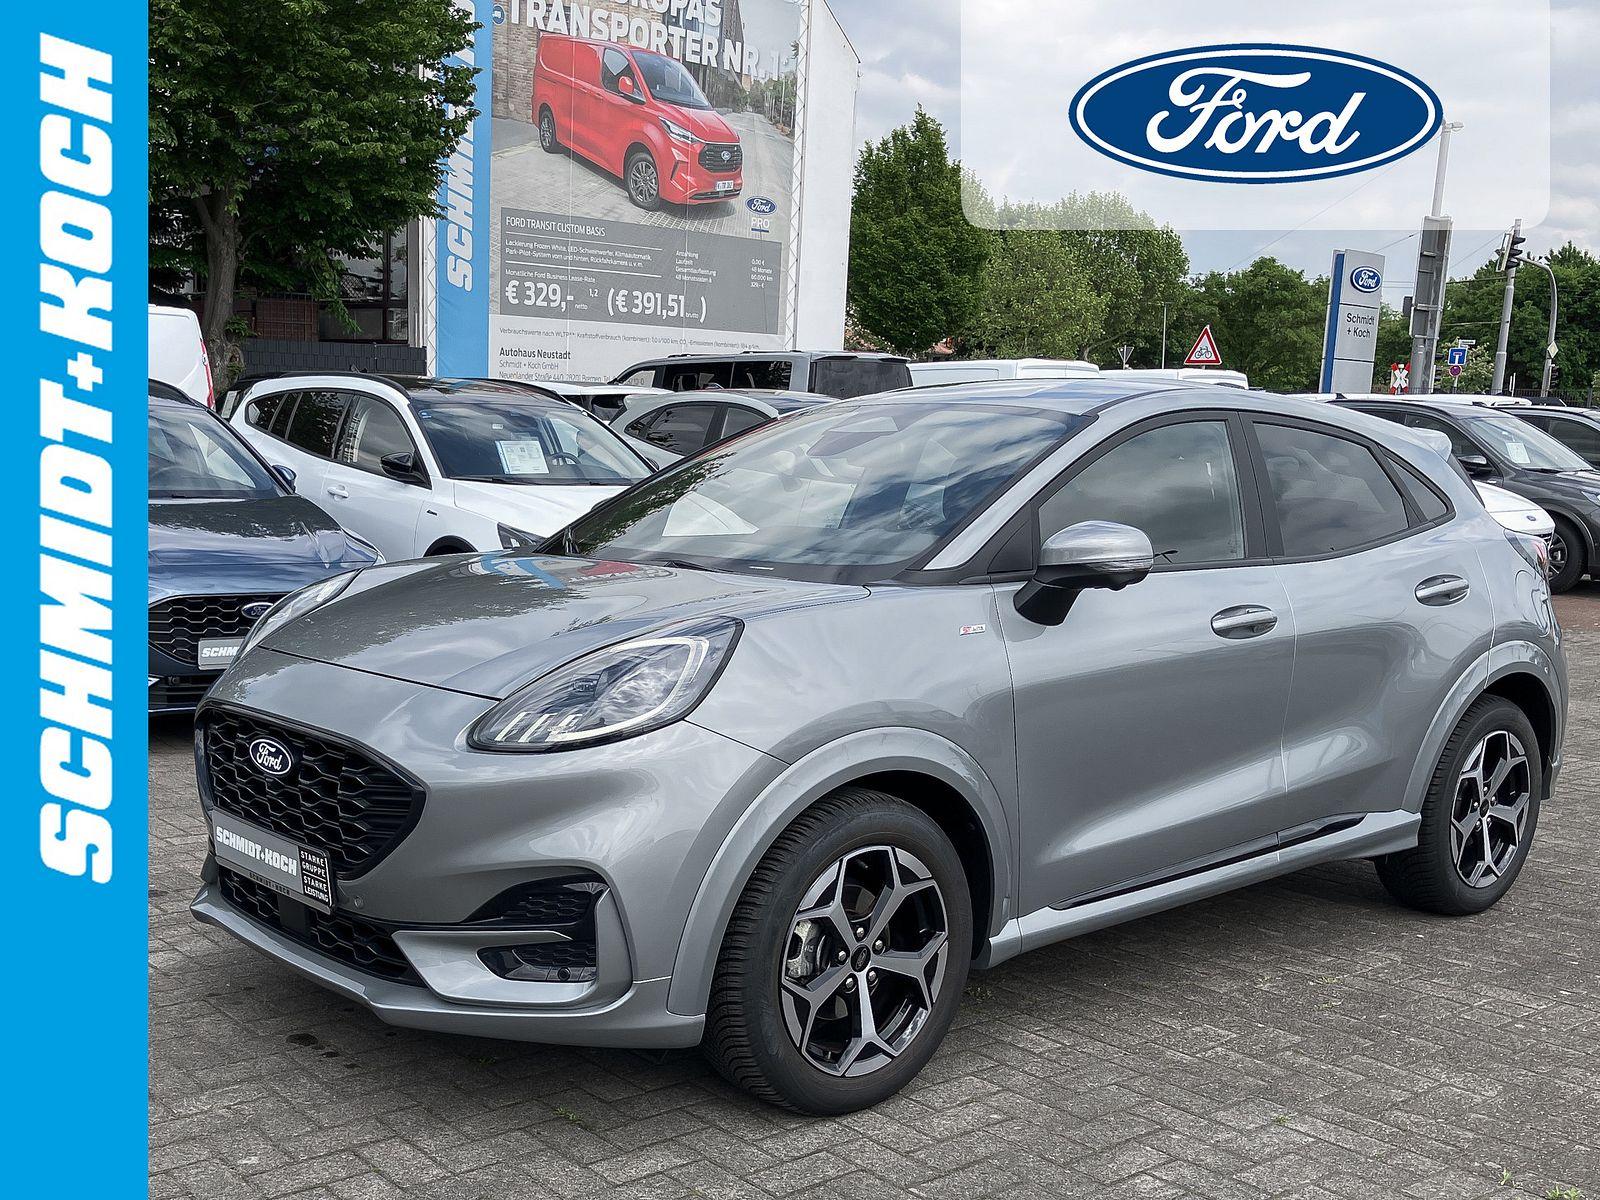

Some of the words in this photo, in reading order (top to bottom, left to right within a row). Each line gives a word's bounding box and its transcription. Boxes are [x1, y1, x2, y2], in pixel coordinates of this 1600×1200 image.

[510, 0, 718, 68] TRANSPORTER
[751, 198, 771, 213] Ford
[506, 216, 526, 228] FORD
[526, 218, 556, 232] TRANSIT
[557, 222, 586, 235] CUSTOM
[586, 226, 606, 237] BASIS
[751, 217, 770, 229] PRO
[1359, 270, 1378, 288] Ford
[505, 280, 519, 304] €
[523, 281, 574, 312] 329,-
[632, 291, 685, 319] 391,51
[1346, 312, 1375, 326] Schmidt
[1353, 326, 1370, 338] Koch
[499, 347, 536, 358] Autohaus
[537, 349, 571, 360] Neustadt
[499, 360, 522, 368] Schmidt
[527, 361, 541, 370] Koch
[542, 362, 559, 370] GmbH
[256, 743, 282, 770] Ford
[216, 826, 298, 877] SCHMIDT+KOCH
[300, 850, 325, 868] STARKE
[302, 862, 326, 878] GRUPPE
[303, 875, 328, 892] STARKE
[304, 885, 329, 903] LEISTUNG
